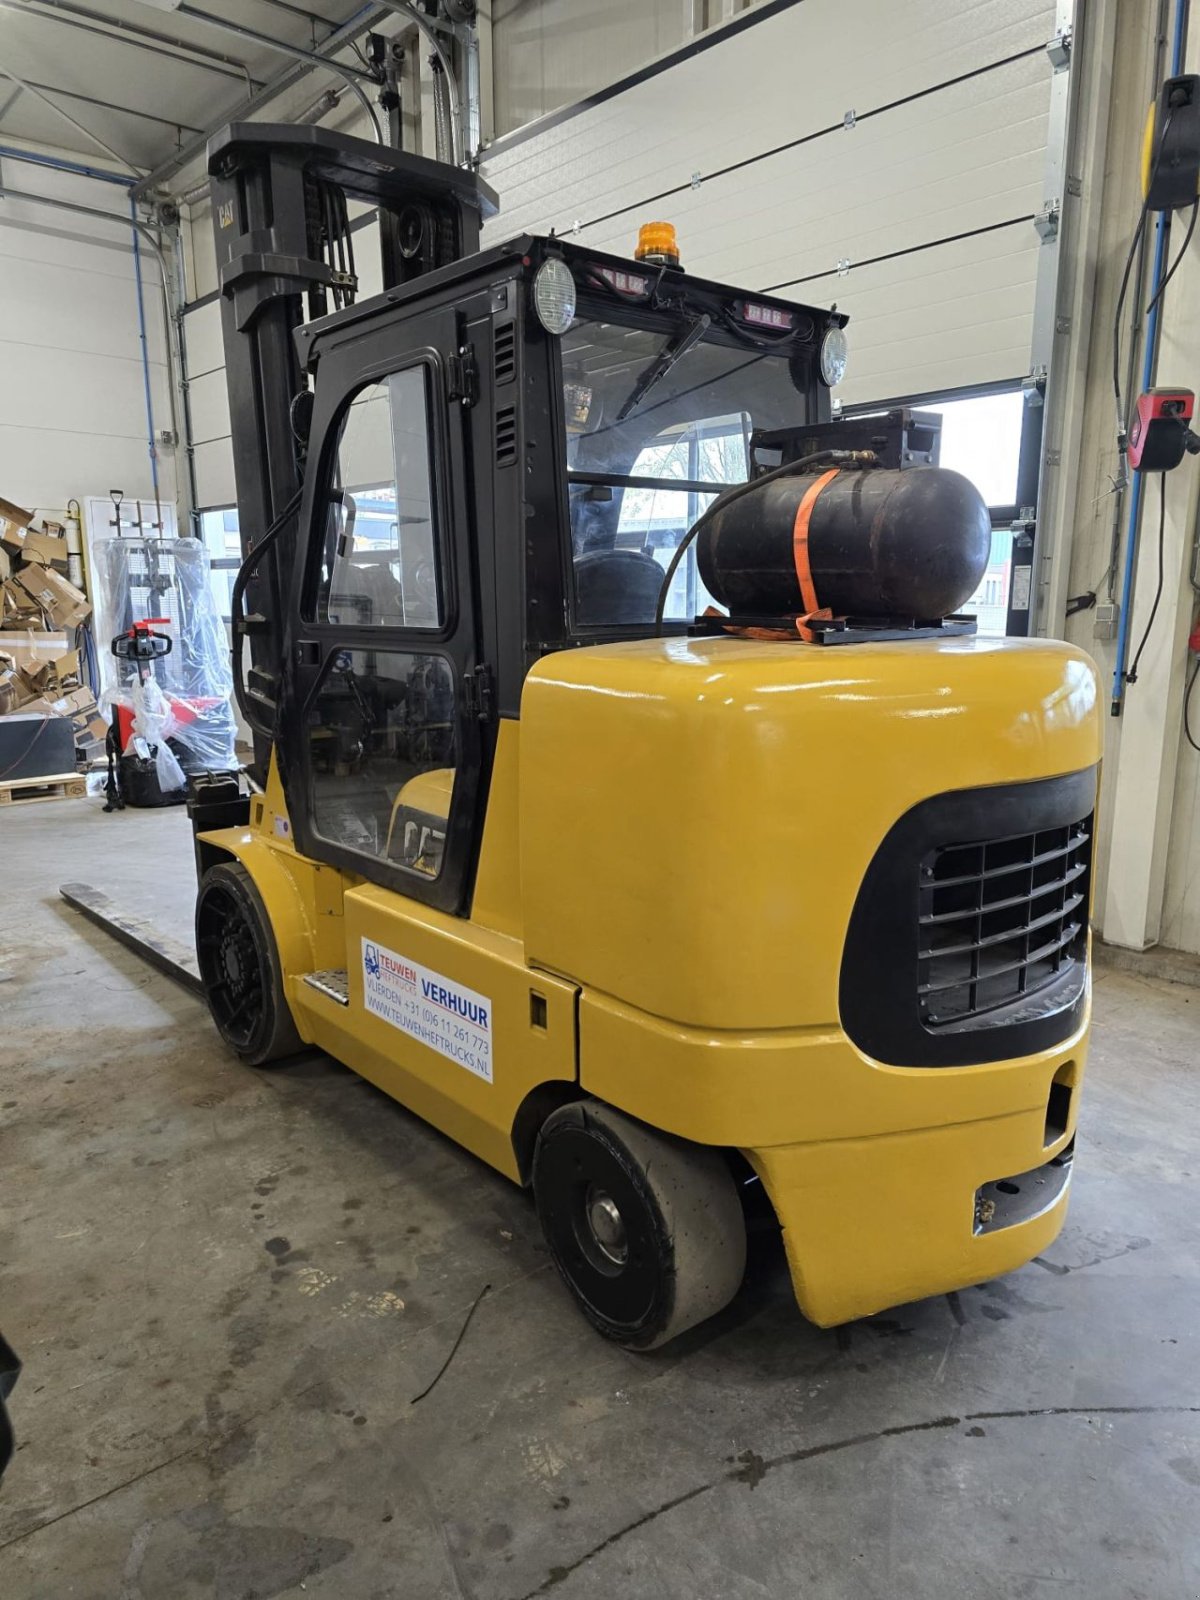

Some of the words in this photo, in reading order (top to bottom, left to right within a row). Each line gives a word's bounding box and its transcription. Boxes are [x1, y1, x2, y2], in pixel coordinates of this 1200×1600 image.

[216, 199, 233, 229] CAT
[380, 954, 416, 982] TEUWEN
[380, 972, 417, 996] HEFTRUCKS
[366, 977, 401, 1006] VLIERDEN
[405, 1001, 419, 1016] +31
[441, 1018, 450, 1033] 11
[454, 1024, 469, 1043] 261
[472, 1034, 489, 1055] 773
[422, 978, 488, 1028] VERHUUR
[367, 994, 490, 1076] WWW.TEUWENHEFTRUCKS.NL
